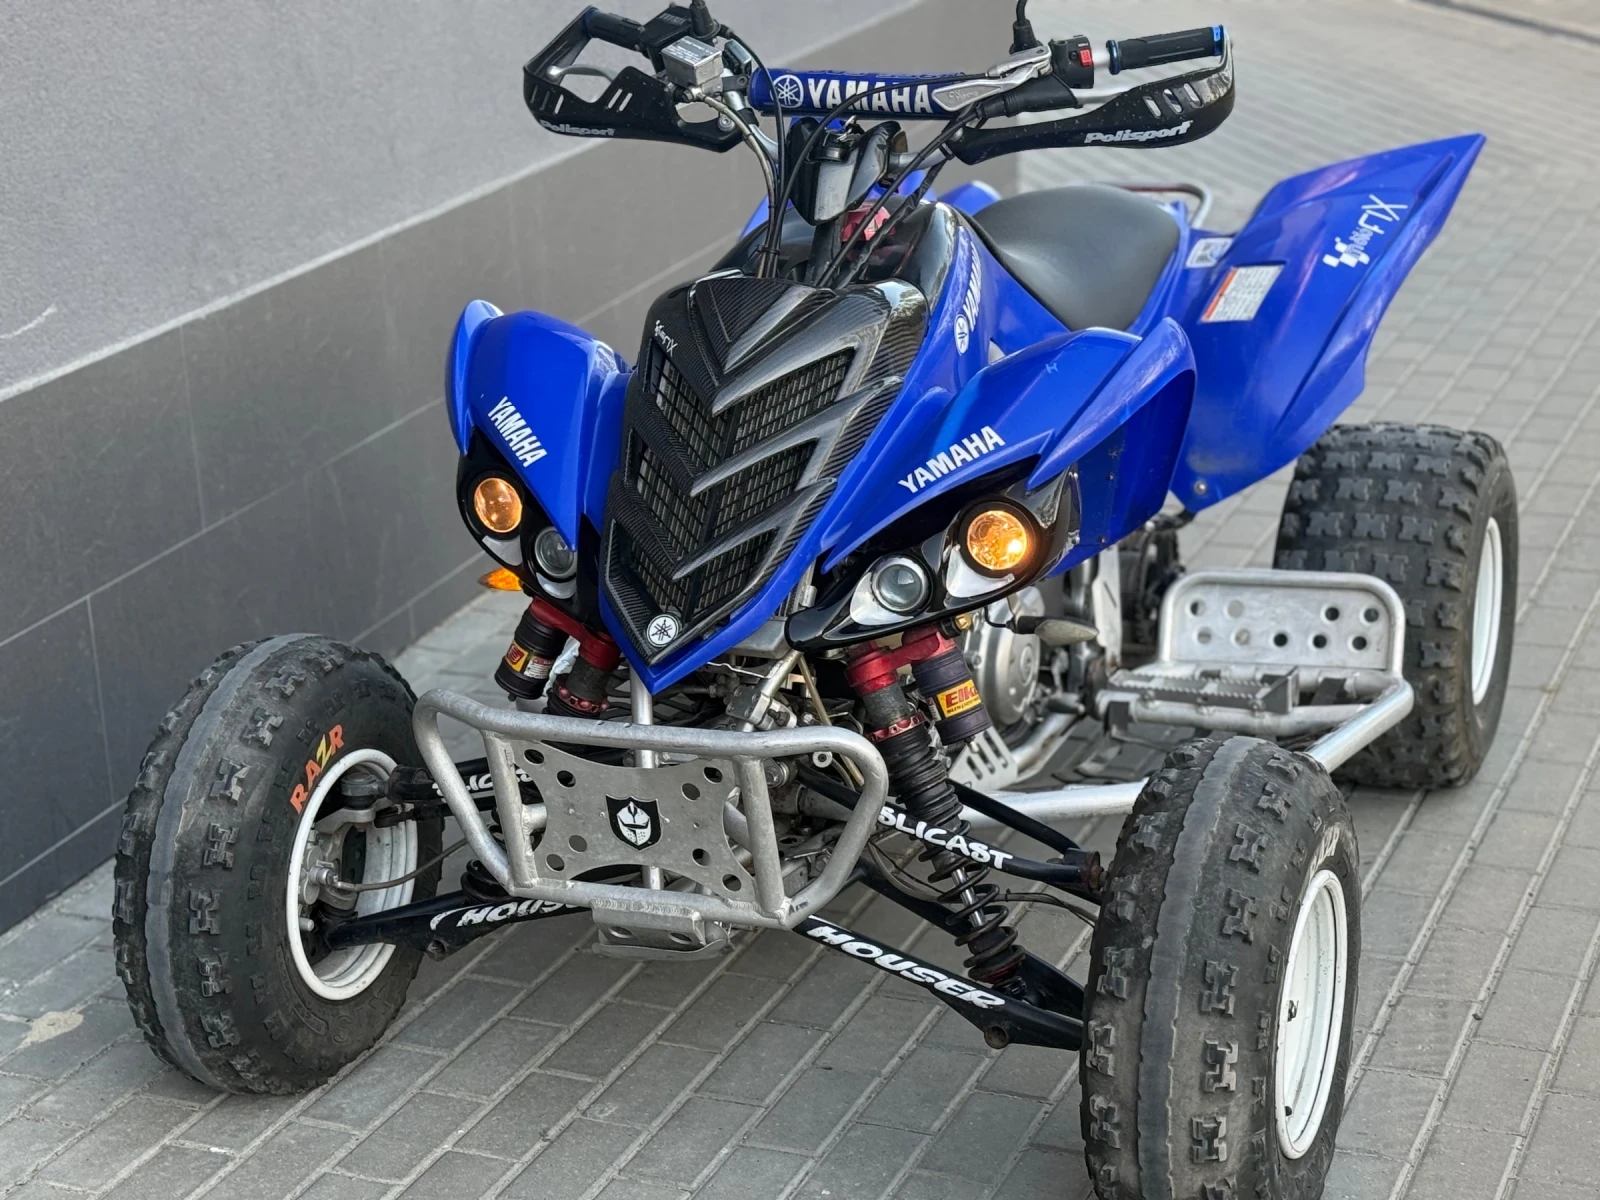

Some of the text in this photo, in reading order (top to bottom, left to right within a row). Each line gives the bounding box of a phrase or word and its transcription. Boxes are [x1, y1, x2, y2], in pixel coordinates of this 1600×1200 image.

[540, 119, 616, 136] Polisport
[808, 78, 933, 113] YAMAHA
[1084, 120, 1194, 144] Polisport
[487, 396, 548, 468] YAMAHA
[898, 425, 1006, 494] YAMAHA
[289, 724, 345, 814] RAZR
[877, 805, 1014, 869] SLICAST
[806, 925, 1005, 1009] HOUSER
